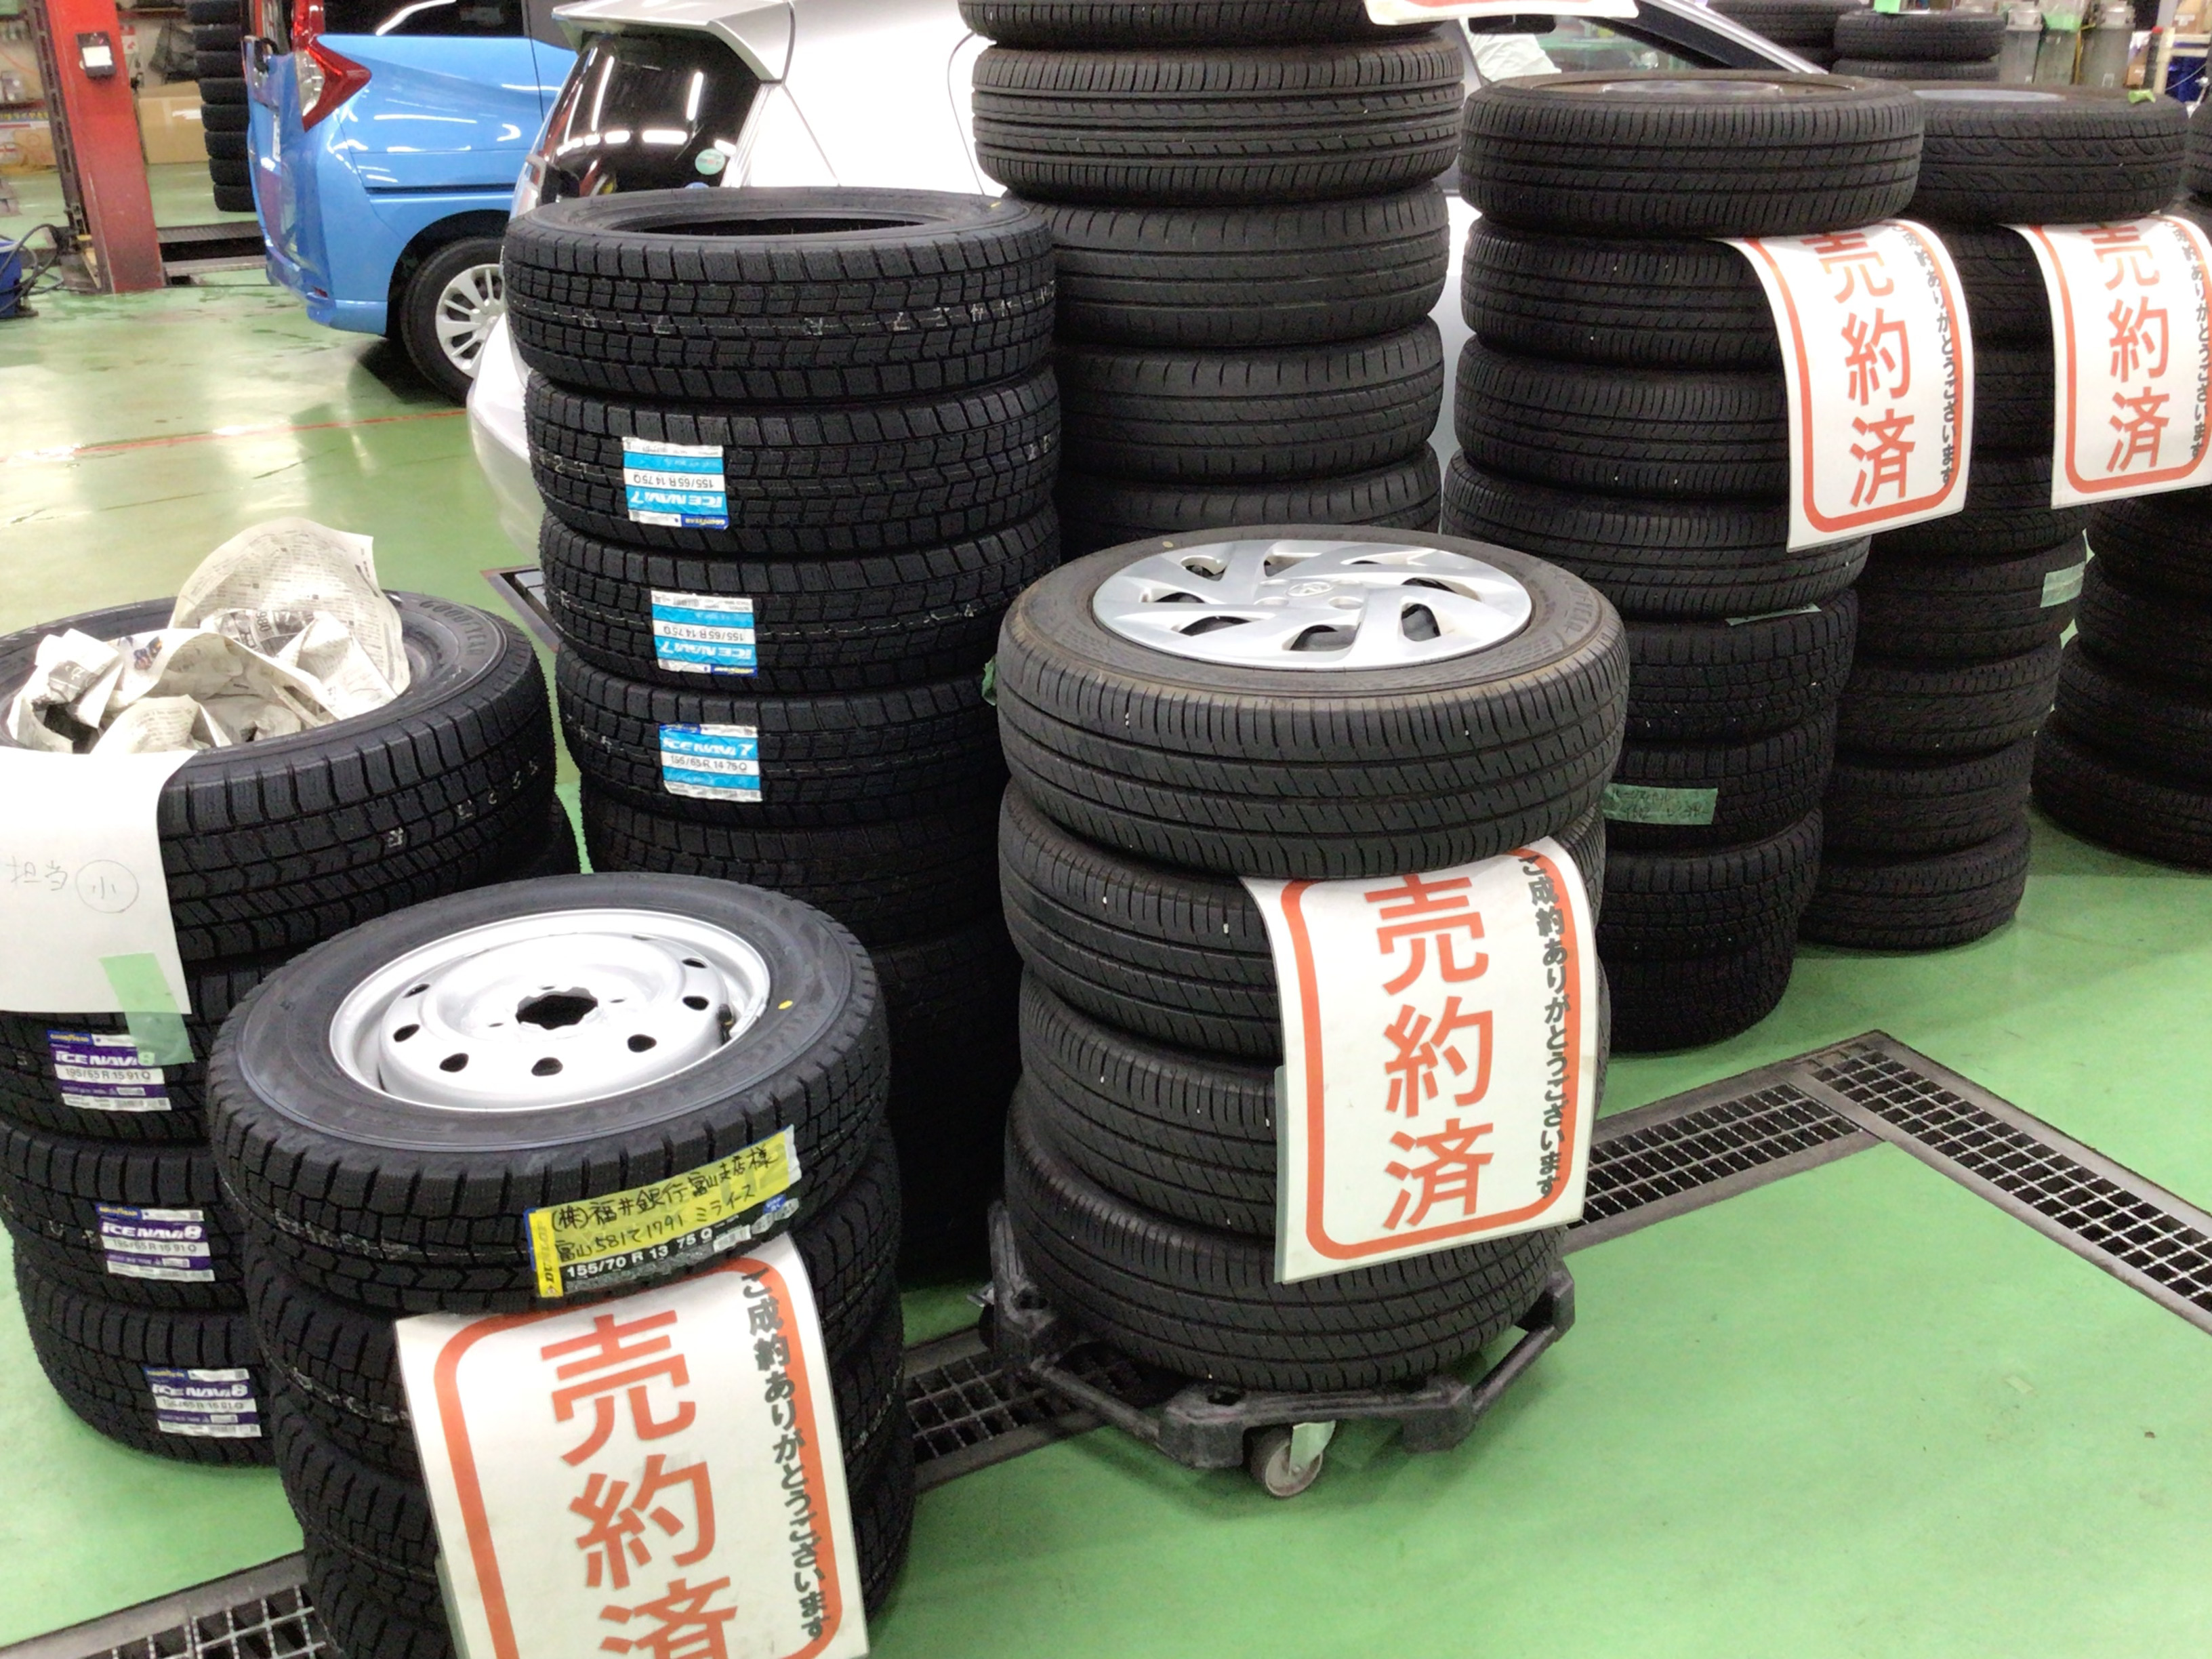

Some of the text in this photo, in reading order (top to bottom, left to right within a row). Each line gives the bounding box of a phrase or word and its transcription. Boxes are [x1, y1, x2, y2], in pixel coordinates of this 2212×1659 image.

[1800, 232, 1916, 507] 売約済
[2078, 226, 2171, 472] 売約済
[689, 495, 723, 508] ICE
[718, 647, 752, 659] ICE
[6, 857, 68, 892] 担当
[56, 1050, 88, 1065] ICE
[1364, 874, 1495, 1230] 売約済
[1519, 855, 1572, 1198] ご成約ありがとうございます
[102, 1222, 136, 1237] ICE
[567, 1256, 626, 1279] 155/70
[631, 1252, 644, 1263] R
[649, 1245, 669, 1259] 13
[541, 1310, 738, 1659] 売約済
[741, 1267, 831, 1641] ご成約ありがとうございます
